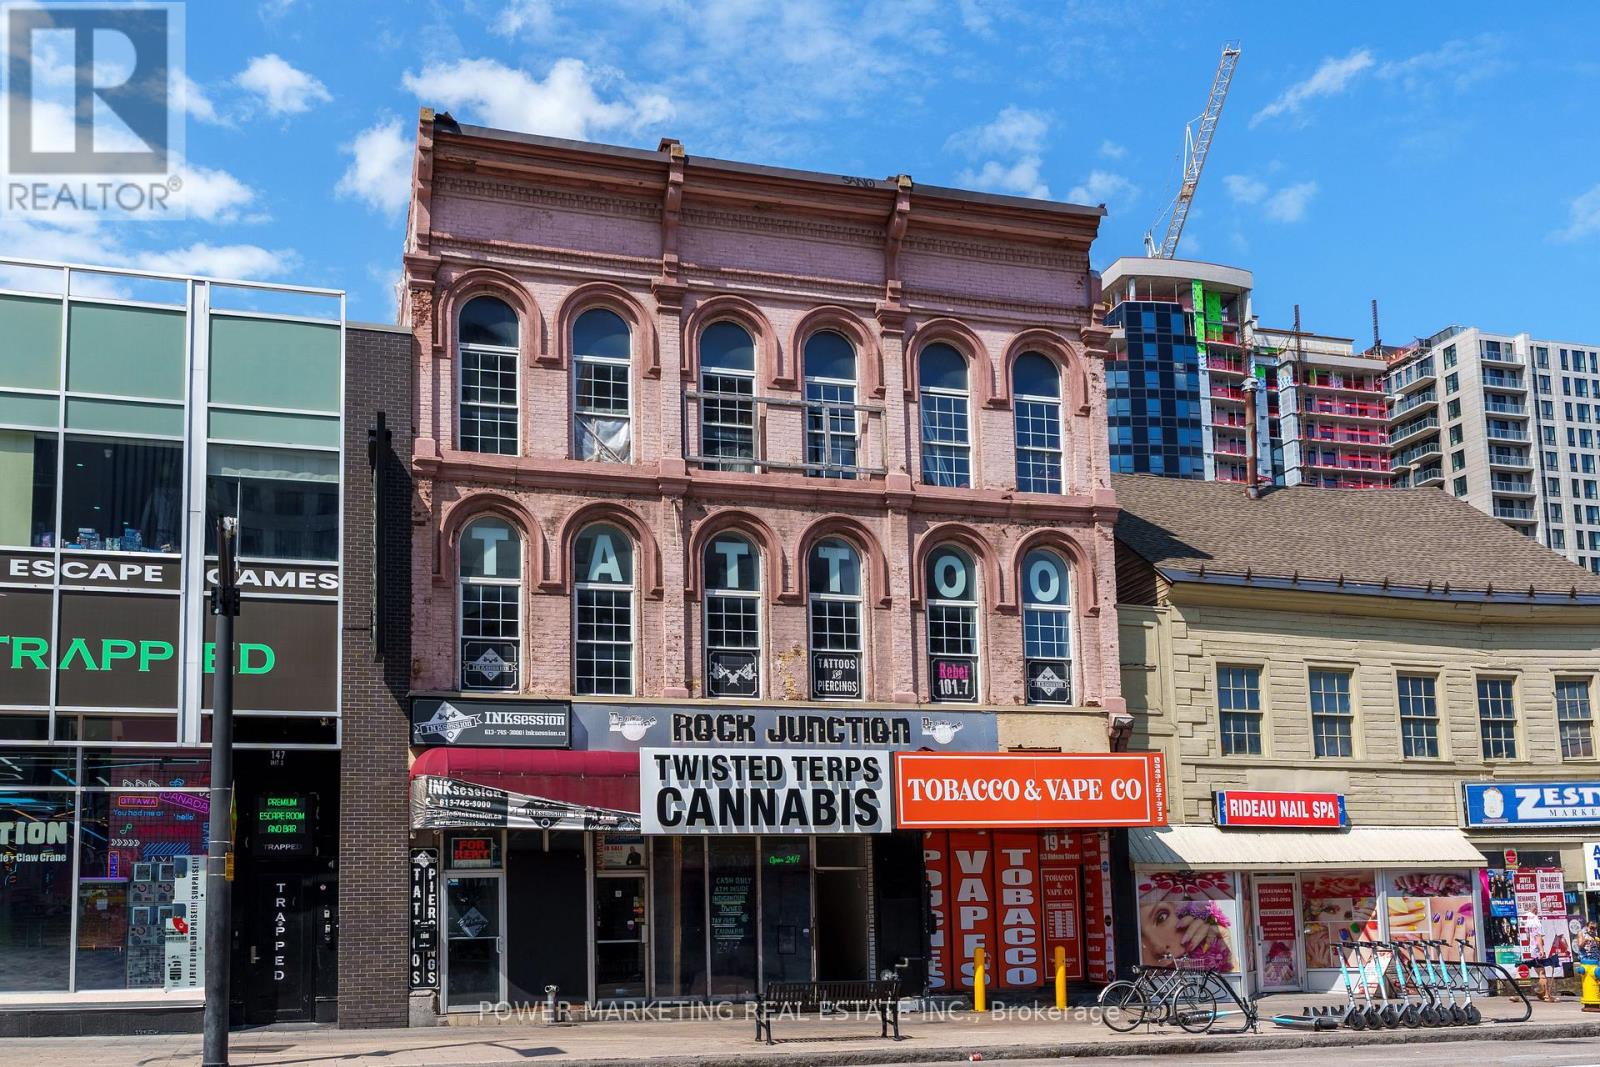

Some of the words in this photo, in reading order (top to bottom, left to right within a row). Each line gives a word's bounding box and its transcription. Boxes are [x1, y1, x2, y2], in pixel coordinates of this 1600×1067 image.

[9, 559, 163, 582] ESCAPE
[818, 658, 856, 670] TATTOOS
[938, 663, 969, 679] Rebel
[817, 680, 858, 692] PIERCINGS
[938, 679, 969, 695] 101.7
[484, 711, 566, 726] INKsession
[671, 713, 756, 743] ROCK
[767, 714, 911, 745] JUNCTION
[271, 750, 286, 760] 147
[653, 754, 784, 782] TWISTED
[791, 756, 880, 783] TERPS
[428, 778, 502, 798] INKsession
[907, 778, 1020, 801] TOBACCO
[1024, 778, 1042, 801] &
[1042, 778, 1103, 801] VAPE
[1110, 778, 1142, 801] CO
[120, 797, 156, 805] OTTAWA
[267, 798, 297, 806] PREMIUM
[656, 786, 880, 827] CANNABIS
[1230, 798, 1276, 818] RIDEAU
[1280, 799, 1309, 819] NAIL
[1313, 800, 1336, 819] SPA
[259, 812, 284, 820] ESCAPE
[285, 812, 305, 820] ROOM
[267, 825, 281, 833] AND
[282, 825, 297, 833] BAR
[458, 840, 486, 849] FOR
[16, 853, 38, 862] Claw
[39, 853, 67, 862] Crane
[454, 849, 489, 859] RENT
[769, 855, 784, 864] Open
[955, 850, 992, 987] VAPES
[1001, 849, 1038, 985] TOBACCO
[273, 883, 287, 981] TRAPPED
[427, 868, 437, 984] PIERNGS
